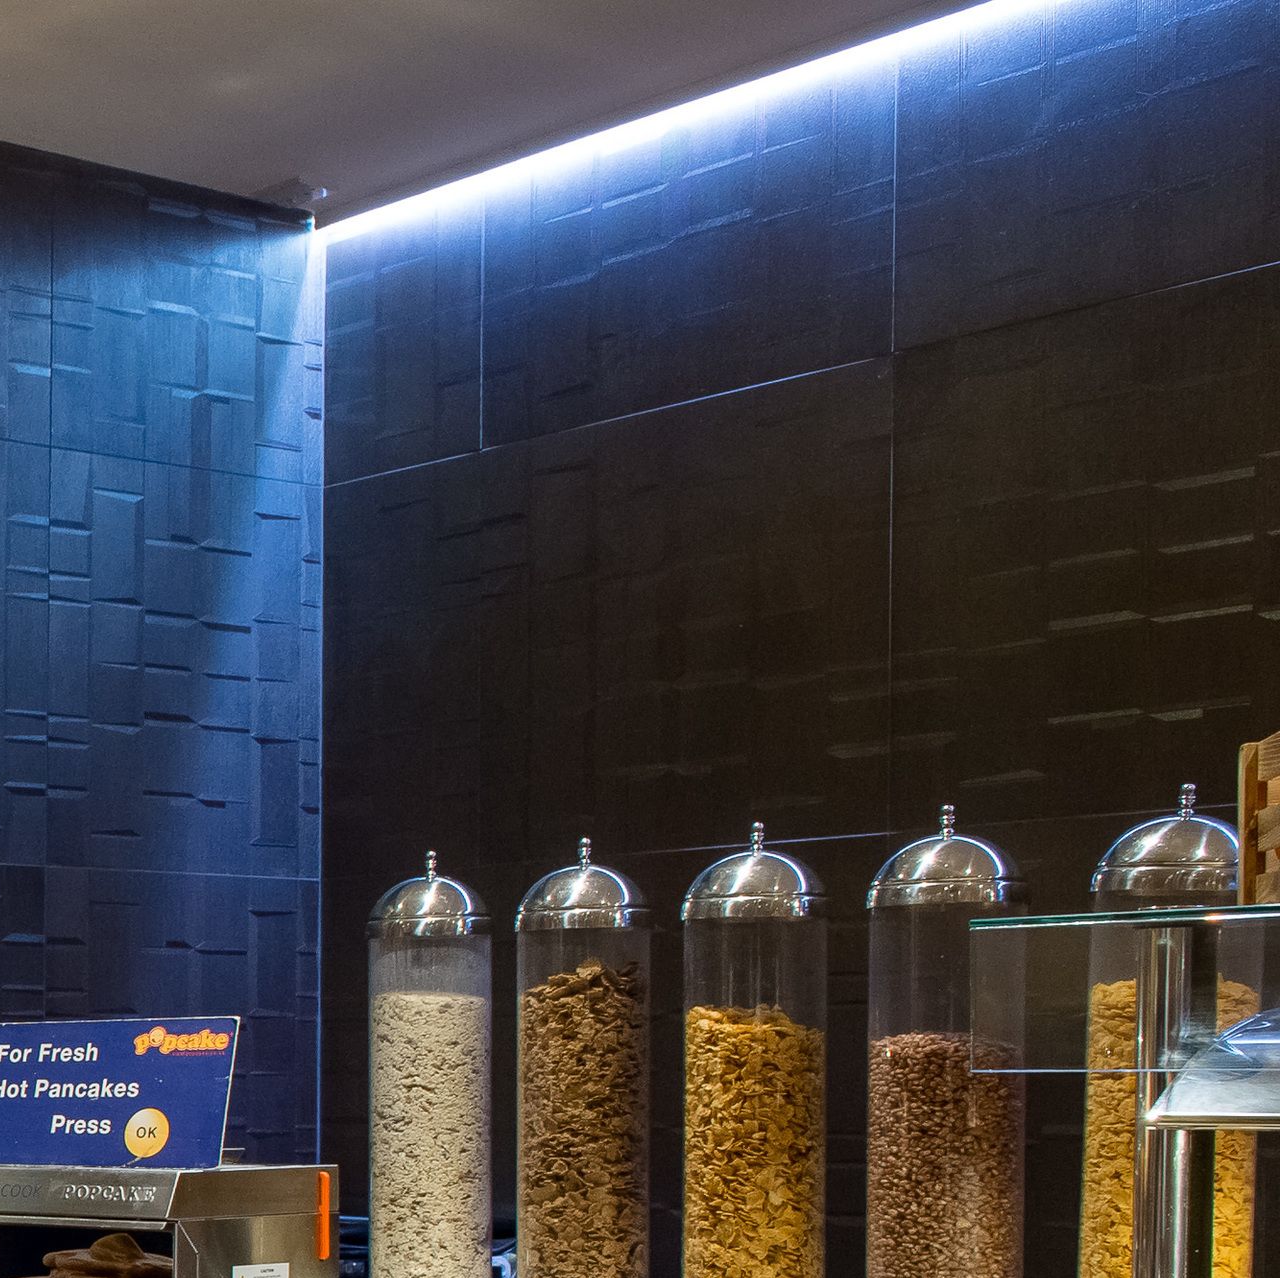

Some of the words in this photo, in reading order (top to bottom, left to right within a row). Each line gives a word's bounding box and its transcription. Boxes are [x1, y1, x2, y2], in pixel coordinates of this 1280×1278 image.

[134, 1026, 229, 1055] popcake
[38, 1043, 99, 1063] Fresh
[34, 1079, 140, 1099] Pancakes
[50, 1114, 112, 1135] Press
[136, 1126, 158, 1139] OK
[0, 1184, 43, 1199] COOK
[62, 1184, 158, 1202] POPCAKE
